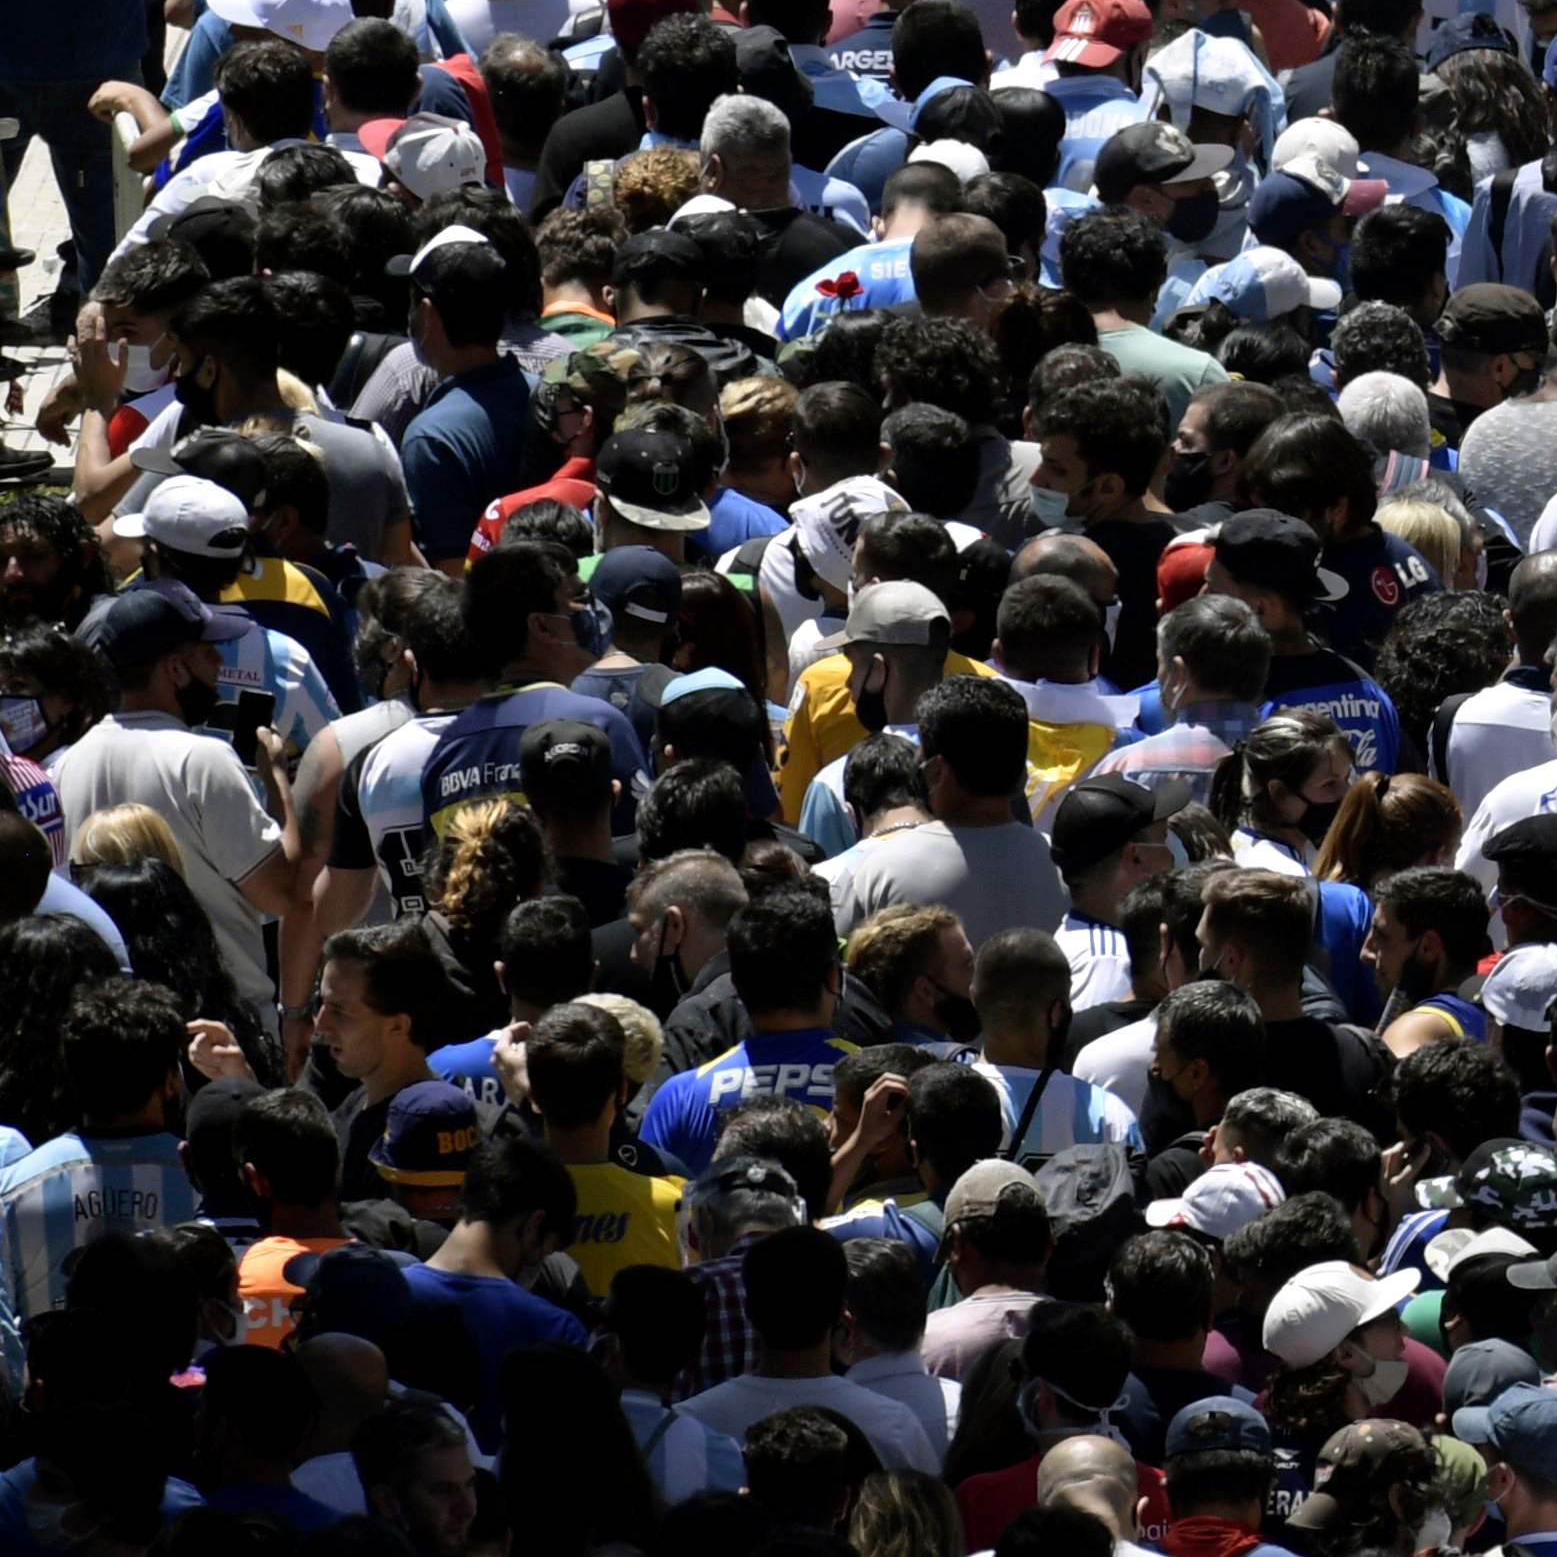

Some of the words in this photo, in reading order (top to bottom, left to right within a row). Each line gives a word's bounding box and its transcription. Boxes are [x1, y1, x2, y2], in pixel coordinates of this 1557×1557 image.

[1394, 556, 1430, 589] LG
[440, 765, 482, 797] BBVA
[709, 1063, 836, 1104] PEPS
[436, 1126, 480, 1155] BOC
[74, 1186, 159, 1222] AGÜERO
